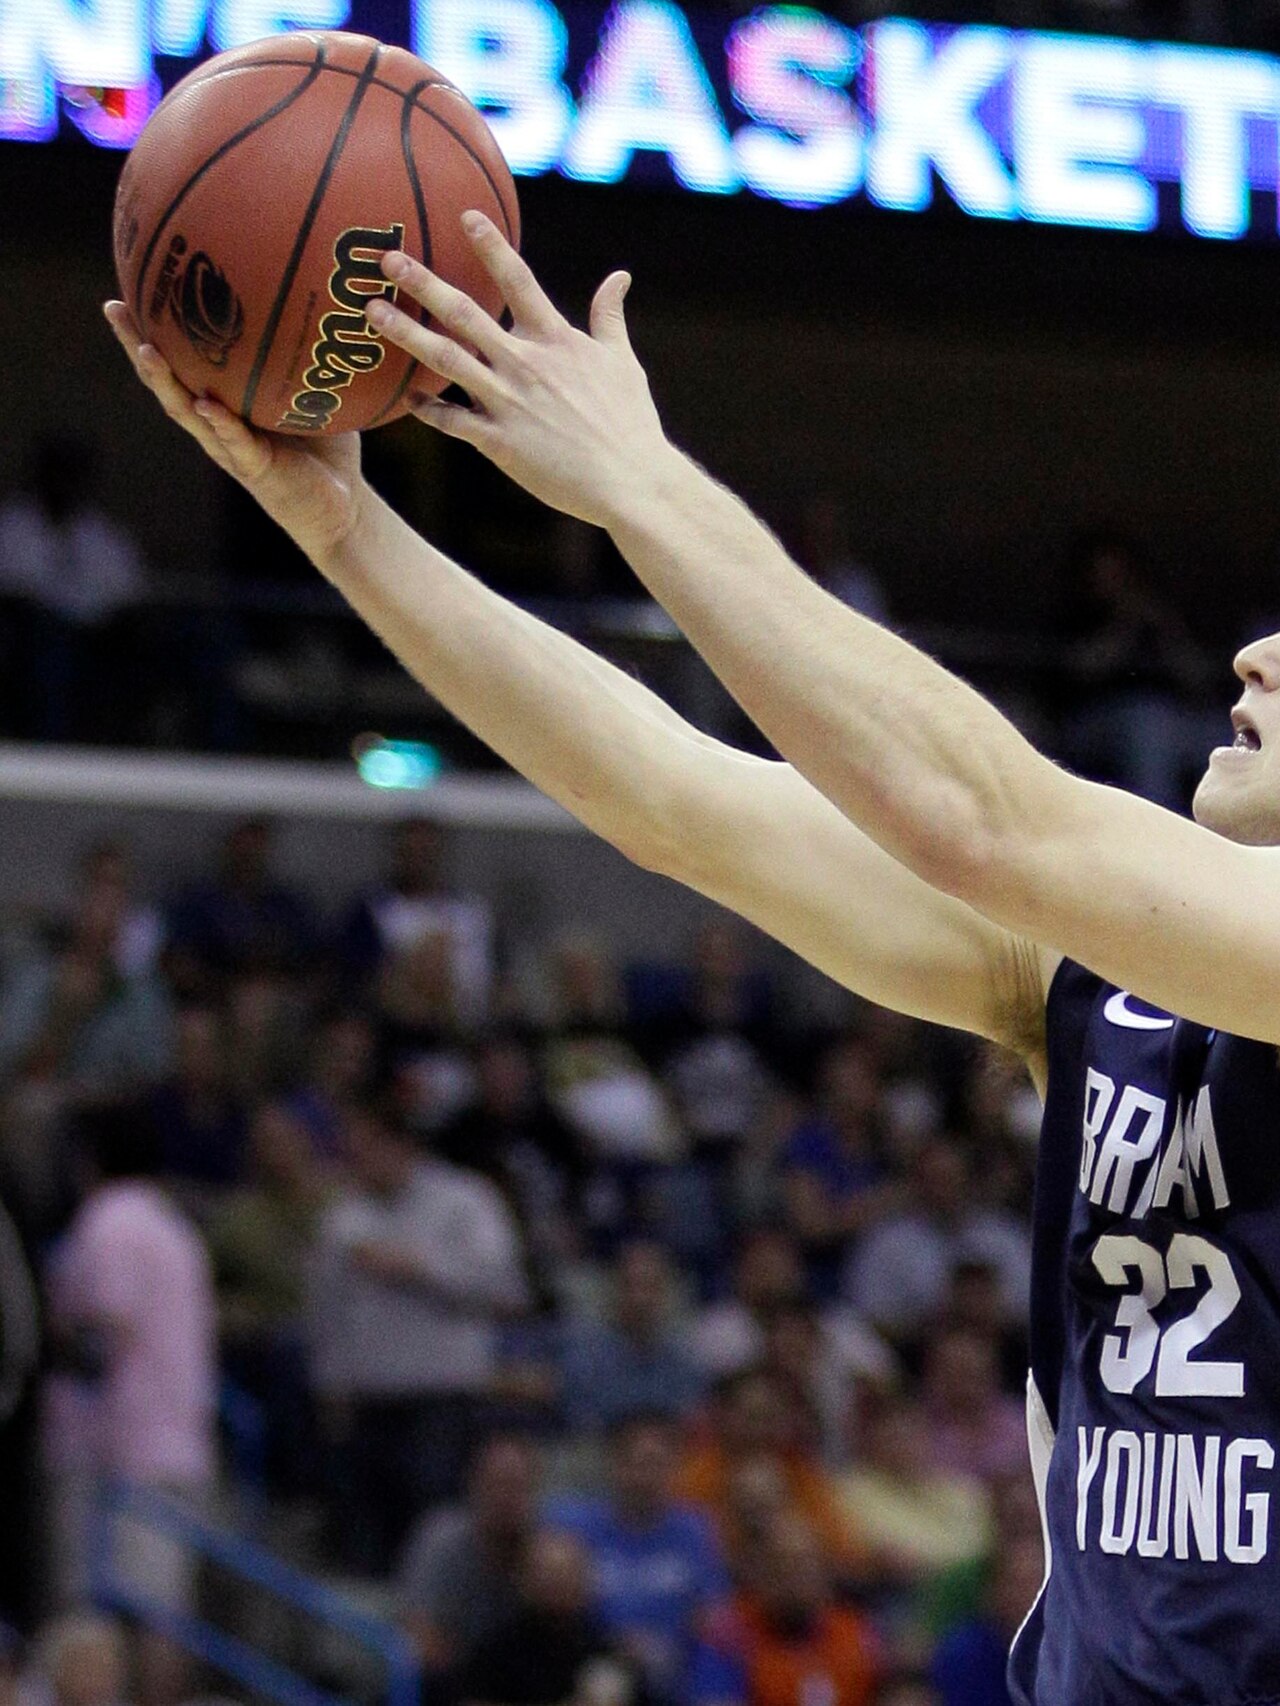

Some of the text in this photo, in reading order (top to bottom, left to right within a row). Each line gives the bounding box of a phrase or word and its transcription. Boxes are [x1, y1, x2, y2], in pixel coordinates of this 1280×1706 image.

[276, 223, 405, 430] Wilson
[1091, 1233, 1246, 1397] 32
[1075, 1426, 1276, 1564] YOUNG
